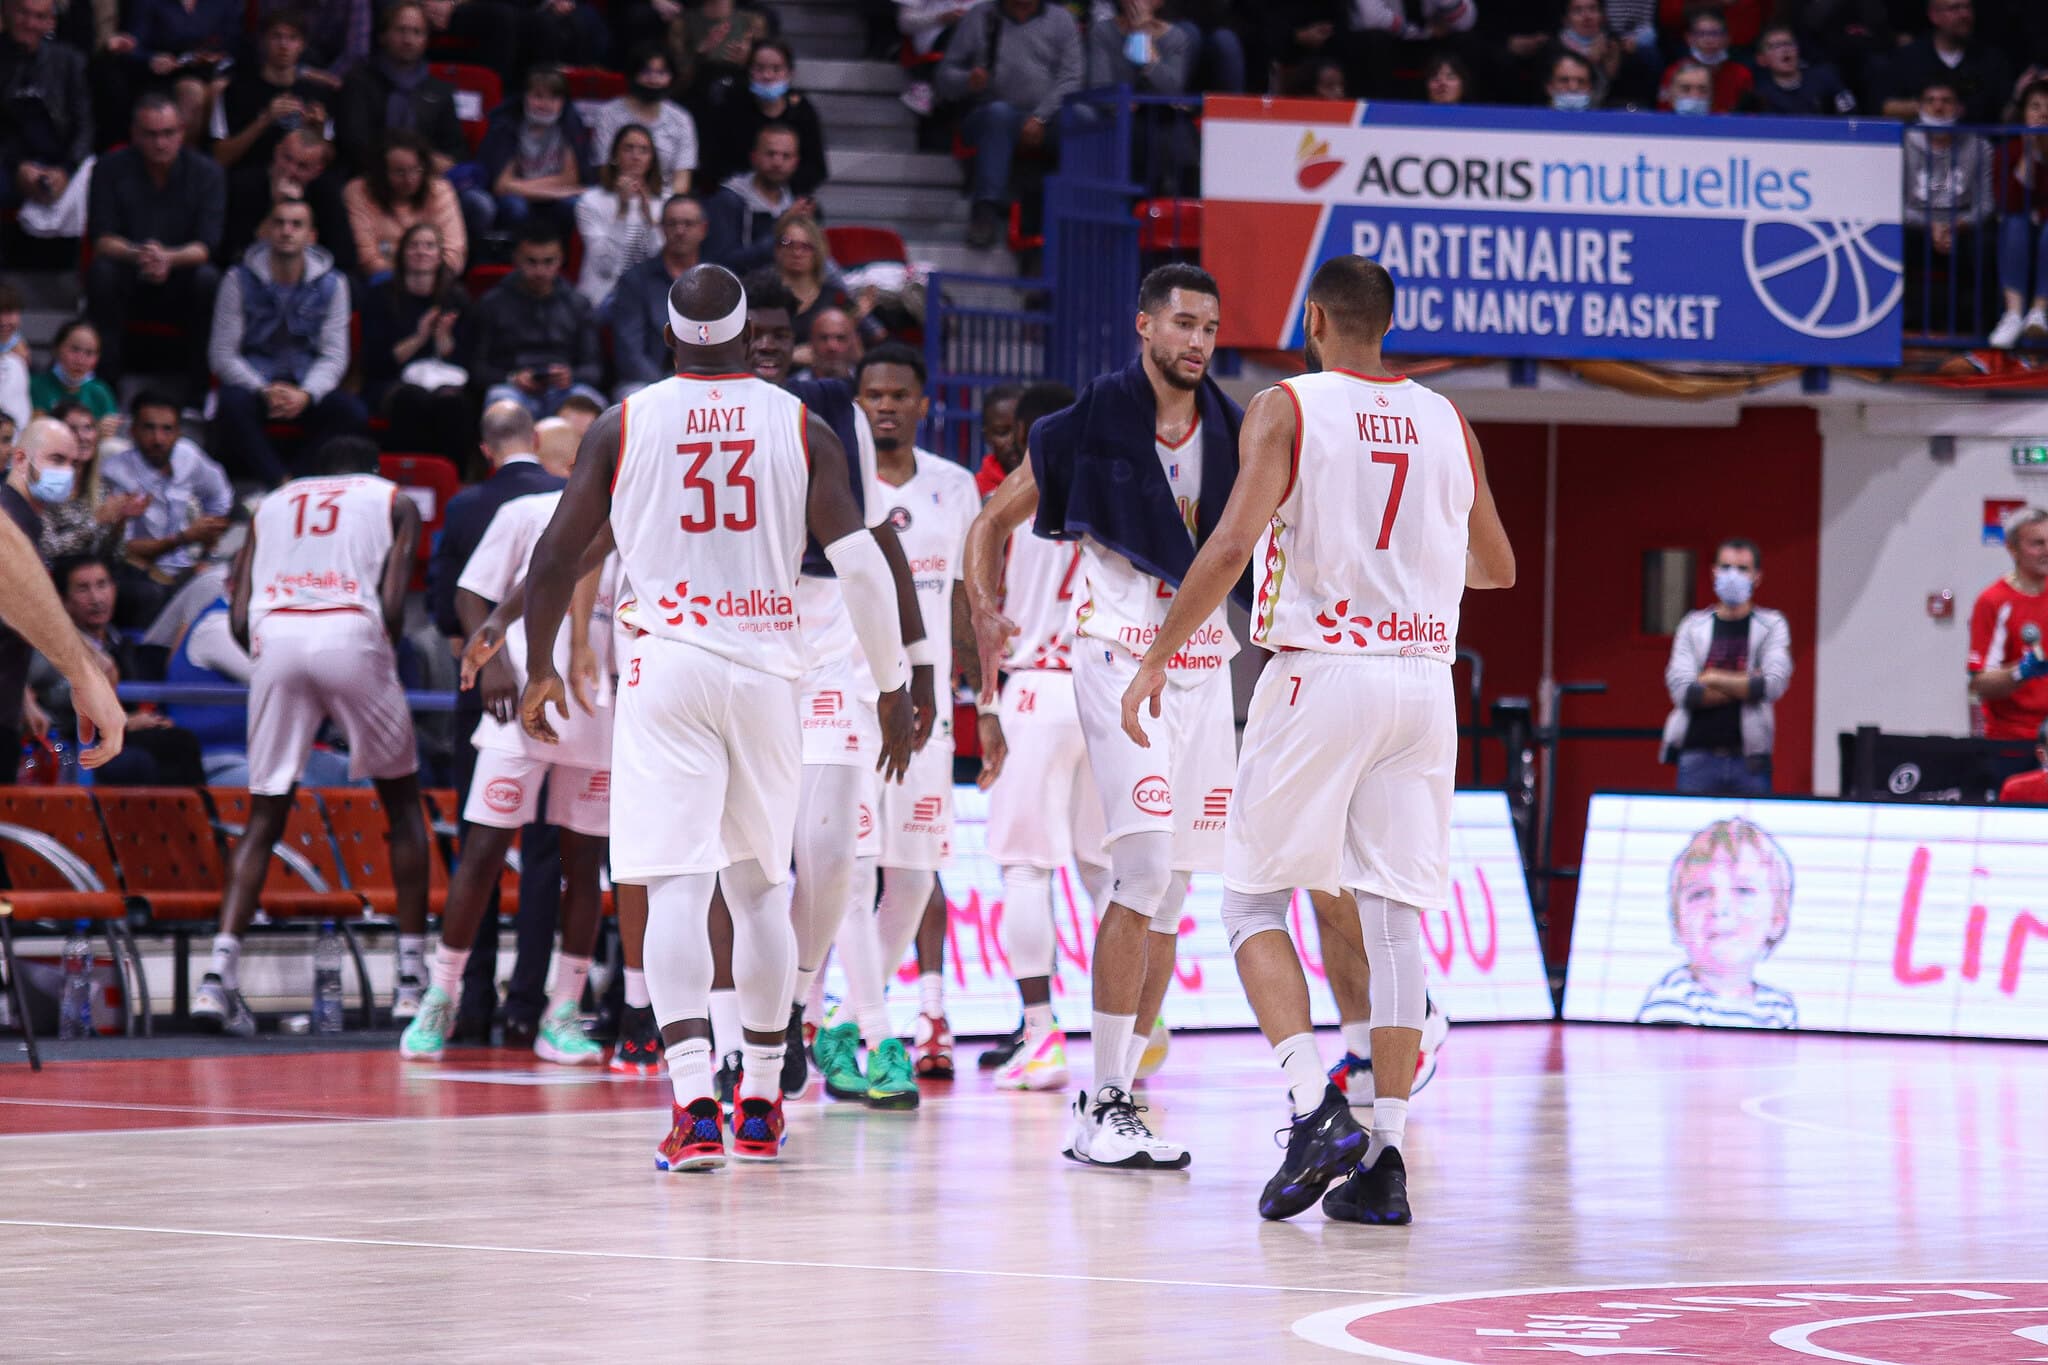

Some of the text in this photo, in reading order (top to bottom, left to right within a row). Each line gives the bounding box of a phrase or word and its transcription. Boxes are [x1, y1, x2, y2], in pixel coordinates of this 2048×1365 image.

[1357, 154, 1813, 211] ACORIS mutuelles
[1352, 220, 1634, 285] PARTENAIRE
[1395, 287, 1720, 341] UC NANCY BASKET
[686, 406, 746, 435] AJAYI
[1356, 412, 1419, 445] KEITA
[676, 439, 757, 533] 33
[1371, 451, 1409, 550] 7
[289, 490, 346, 538] 13
[716, 589, 793, 617] dalkia
[738, 622, 772, 632] GROUPE
[1377, 612, 1448, 642] dalkia
[1290, 676, 1302, 706] 7
